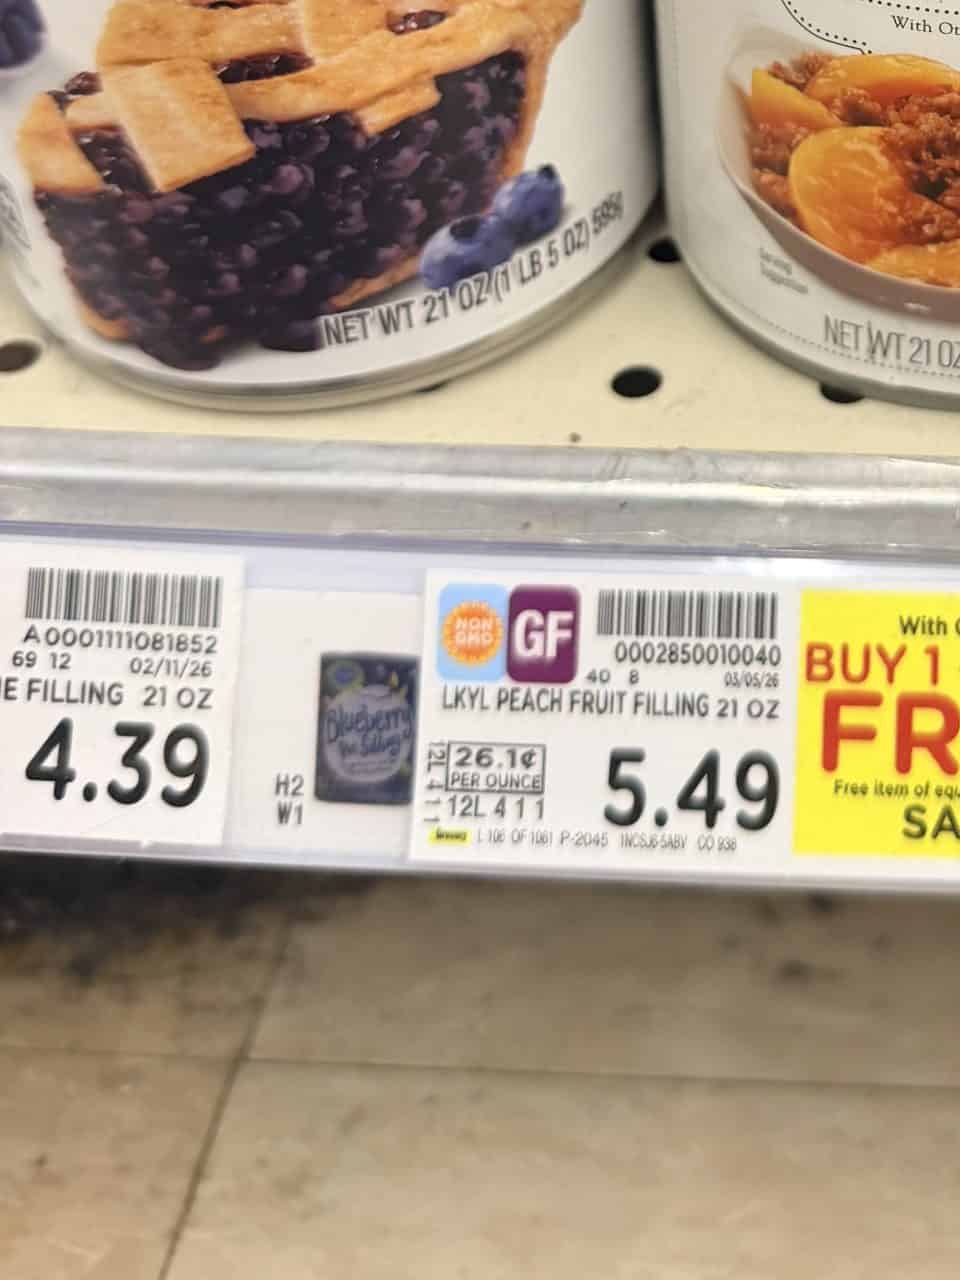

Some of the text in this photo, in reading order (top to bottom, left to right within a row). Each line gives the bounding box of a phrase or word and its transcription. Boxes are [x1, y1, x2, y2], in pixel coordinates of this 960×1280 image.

[890, 14, 932, 36] With
[323, 312, 371, 347] NET
[376, 301, 416, 336] WT
[423, 293, 449, 325] 21
[458, 274, 490, 312] OZ
[517, 253, 543, 288] LB
[548, 241, 559, 269] 5
[563, 216, 591, 257] OZ)
[824, 314, 864, 346] NET
[867, 320, 904, 361] WT
[908, 335, 932, 366] 21
[514, 609, 574, 658] GF
[899, 615, 949, 638] With
[11, 651, 213, 678] 69 12 02/11/26
[614, 641, 782, 667] 0002850010040
[804, 641, 908, 686] BUY
[924, 645, 940, 686] 1
[586, 669, 611, 685] 40
[26, 677, 214, 709] FILLING 21 OZ
[442, 685, 781, 719] LKYL PEACH FRUIT FILLING 21 OZ
[25, 716, 210, 808] 4.39
[455, 746, 537, 769] 26.1¢
[274, 774, 305, 798] H2
[451, 771, 541, 790] PER OUNCE
[603, 747, 781, 831] 5.49
[833, 778, 868, 797] Free
[873, 779, 909, 799] item
[913, 779, 930, 799] of
[276, 803, 304, 826] W1
[448, 794, 545, 821] 12L 4 1 1
[559, 830, 609, 849] P-2045
